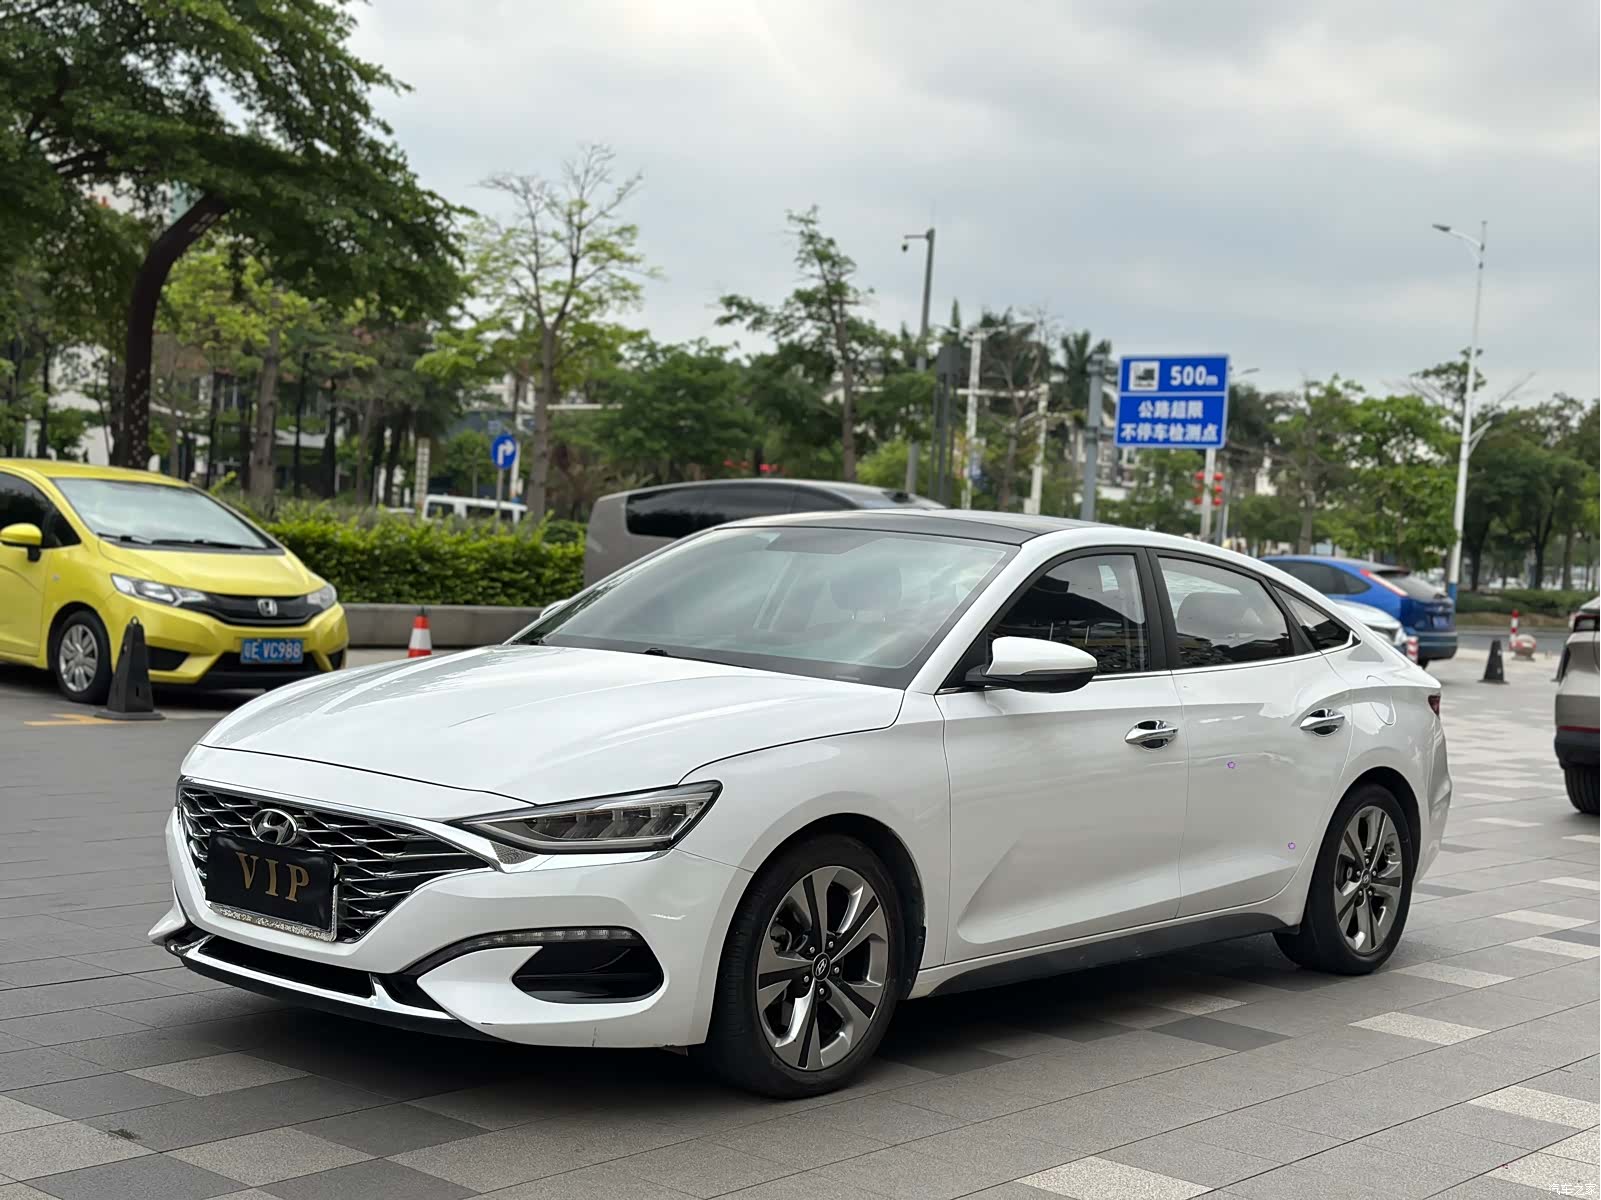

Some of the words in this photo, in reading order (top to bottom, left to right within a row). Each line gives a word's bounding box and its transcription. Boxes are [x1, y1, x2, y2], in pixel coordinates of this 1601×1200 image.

[1138, 399, 1204, 419] 公路超限
[1120, 422, 1218, 442] 不停车检测点
[236, 851, 310, 902] VIP
